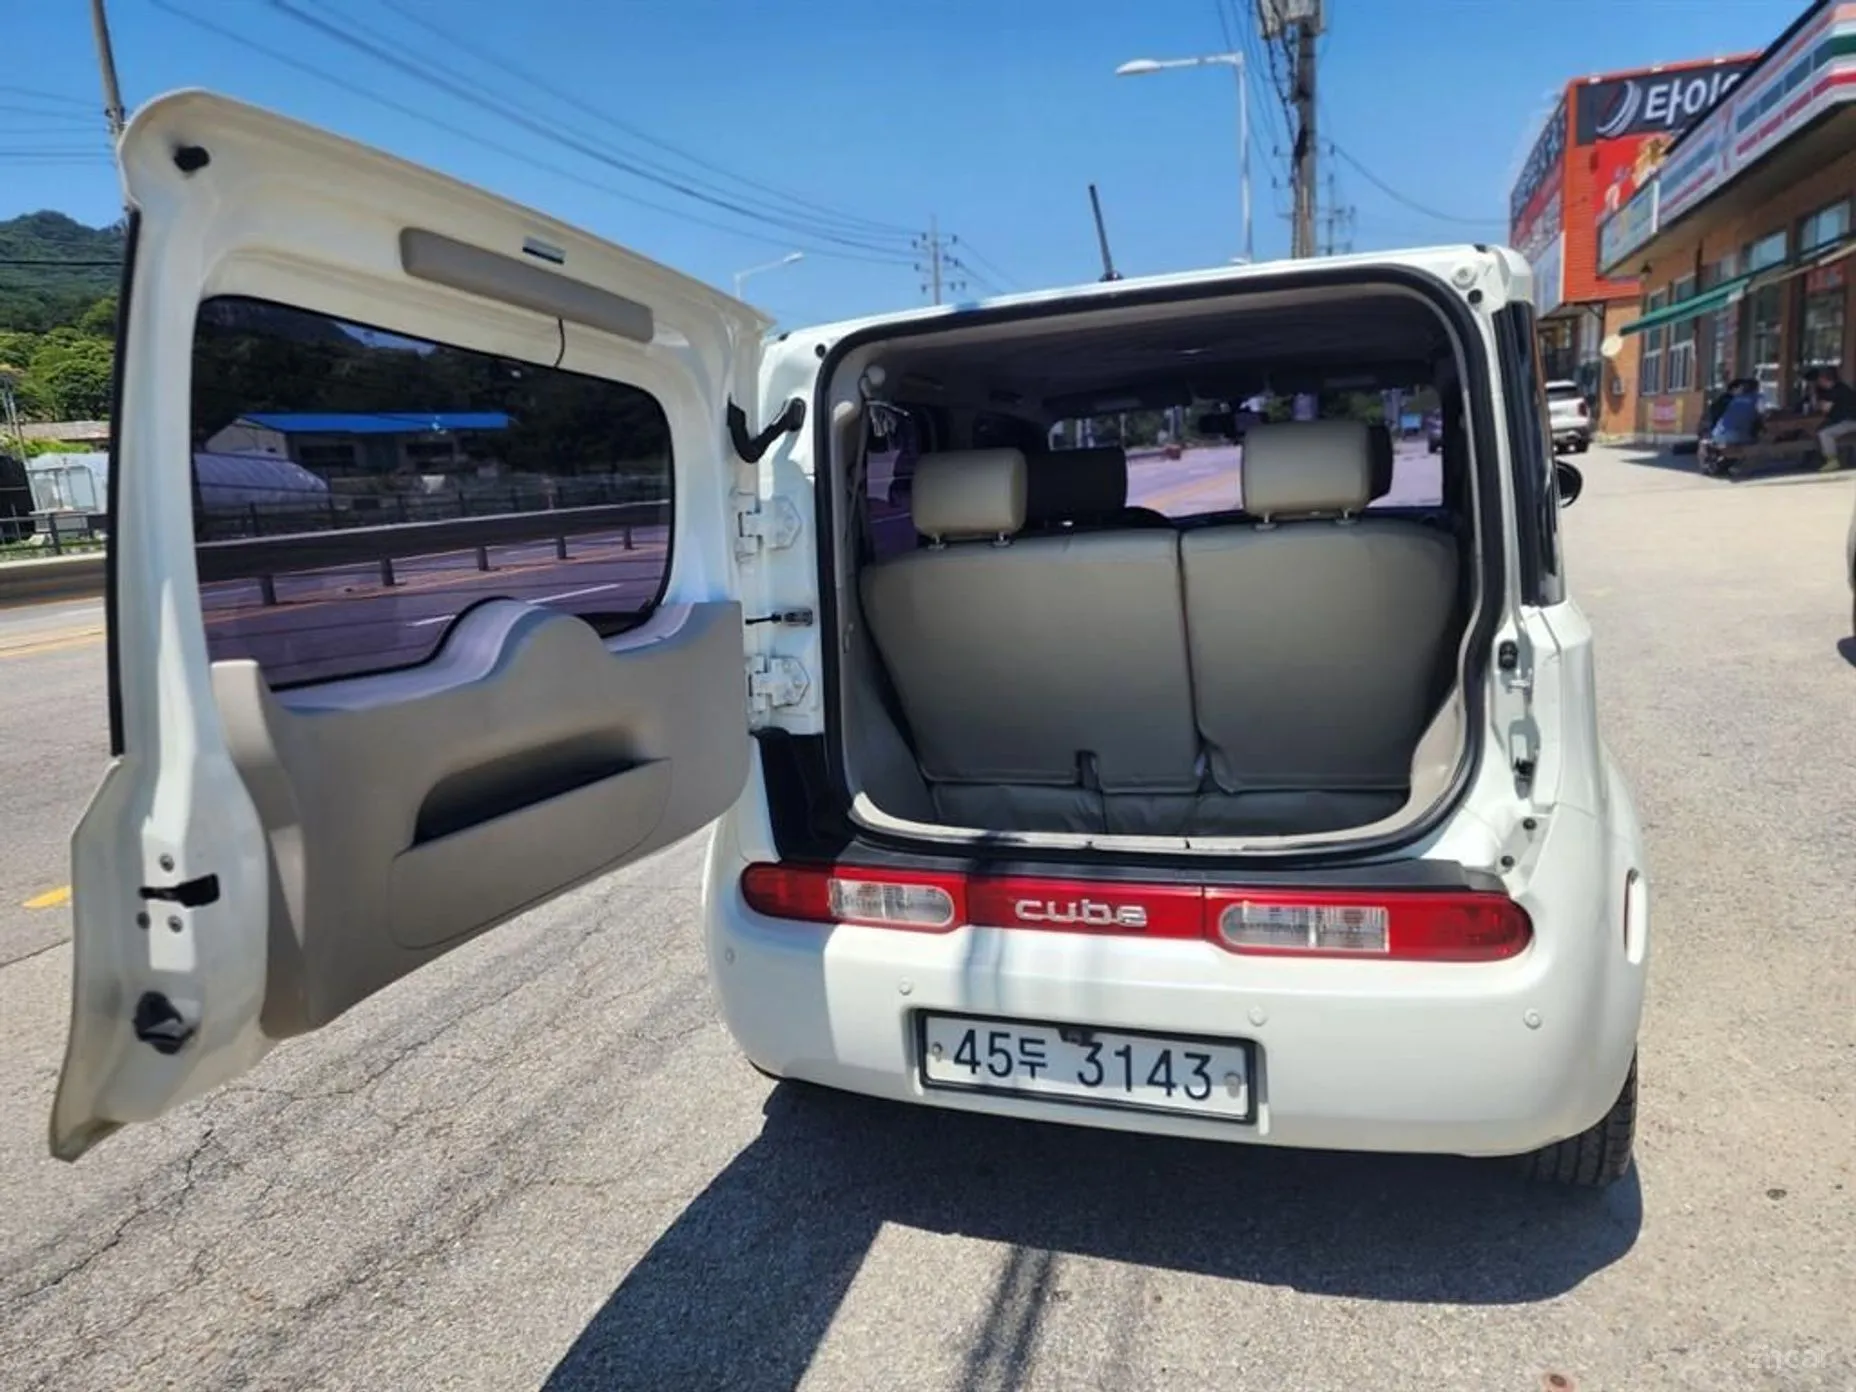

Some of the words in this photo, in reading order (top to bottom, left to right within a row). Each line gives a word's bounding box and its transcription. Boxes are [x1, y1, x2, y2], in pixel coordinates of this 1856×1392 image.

[1015, 898, 1147, 928] cube
[953, 1028, 1048, 1079] 45두
[1077, 1042, 1213, 1101] 3143
